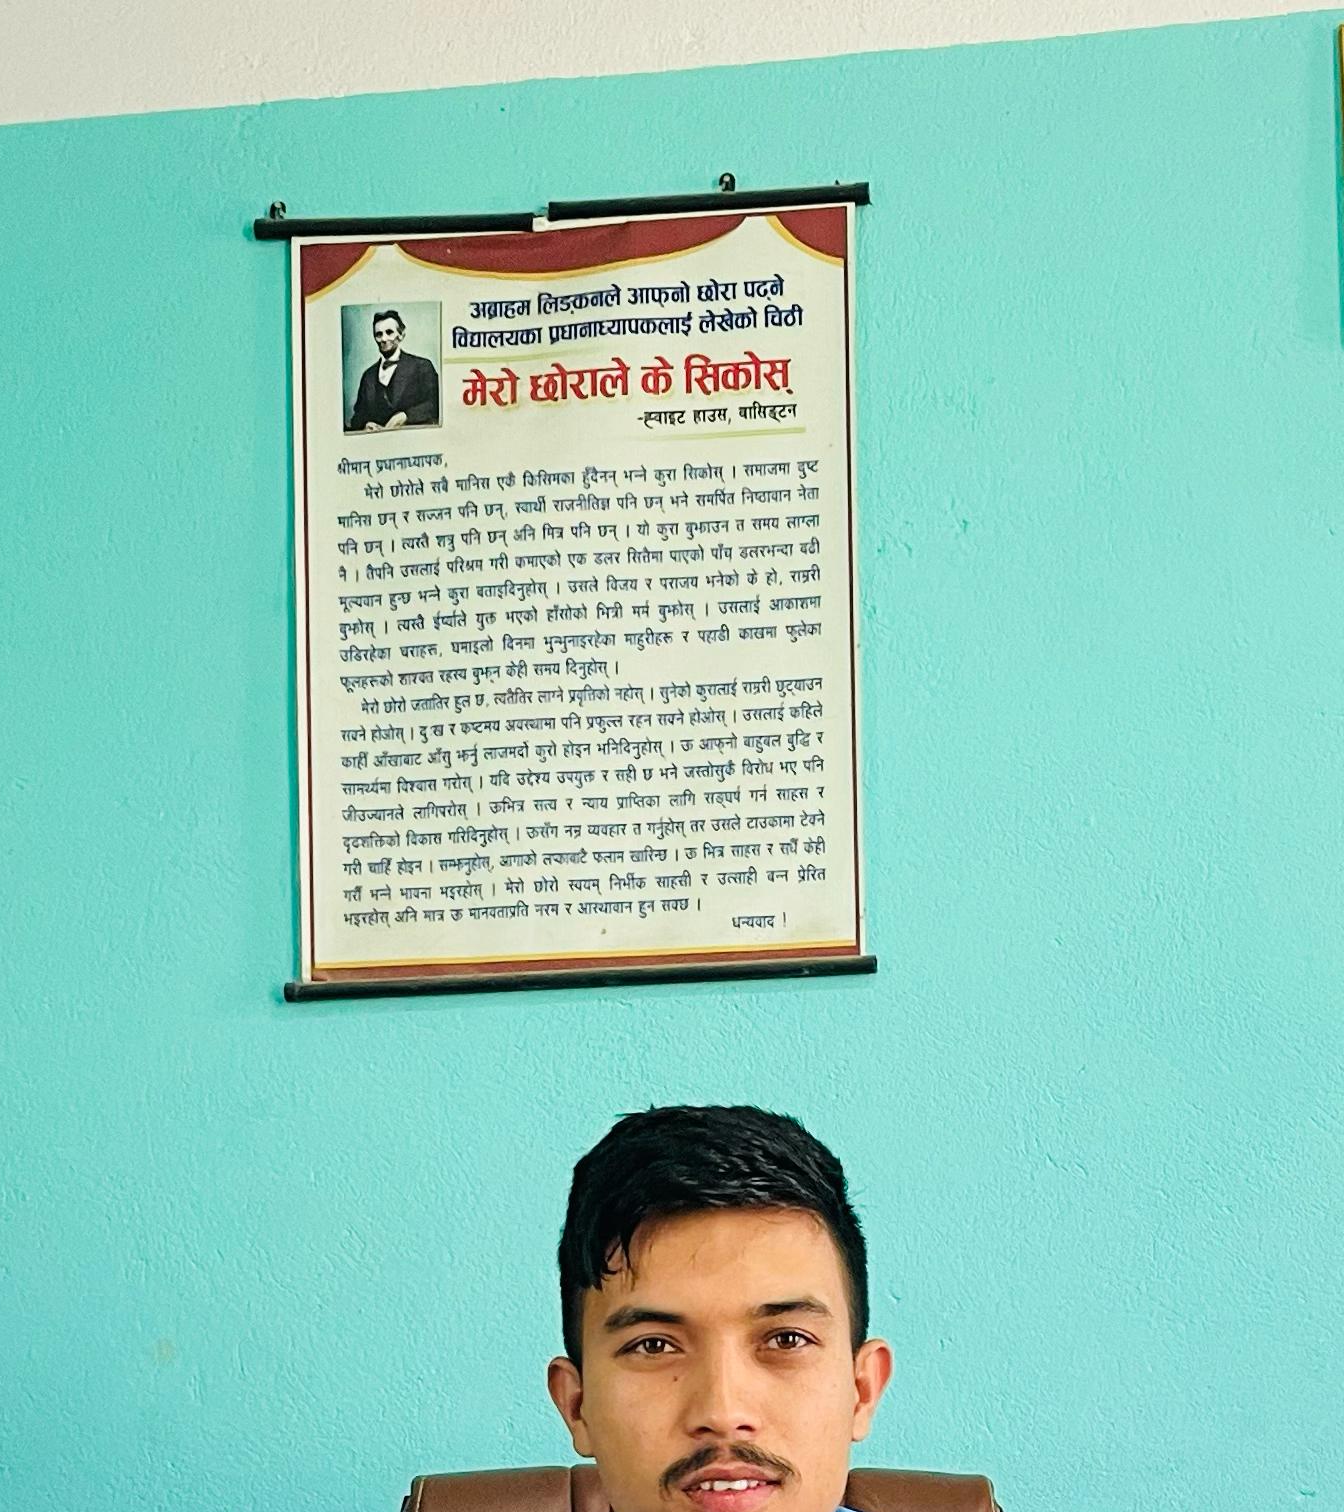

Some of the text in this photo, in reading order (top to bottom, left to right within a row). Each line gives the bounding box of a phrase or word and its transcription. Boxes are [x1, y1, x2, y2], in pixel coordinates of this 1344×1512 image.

[469, 299, 530, 319] अब्राहम
[627, 280, 689, 307] आफ्नो
[696, 278, 737, 301] छोरा
[743, 273, 784, 300] पढ्ने
[452, 325, 542, 348] विद्यालयका
[698, 305, 757, 333] लेखेको
[764, 303, 803, 327] चिठी
[462, 350, 792, 406] मेरो छोराले के सिकोस्
[693, 407, 731, 424] हाउस,
